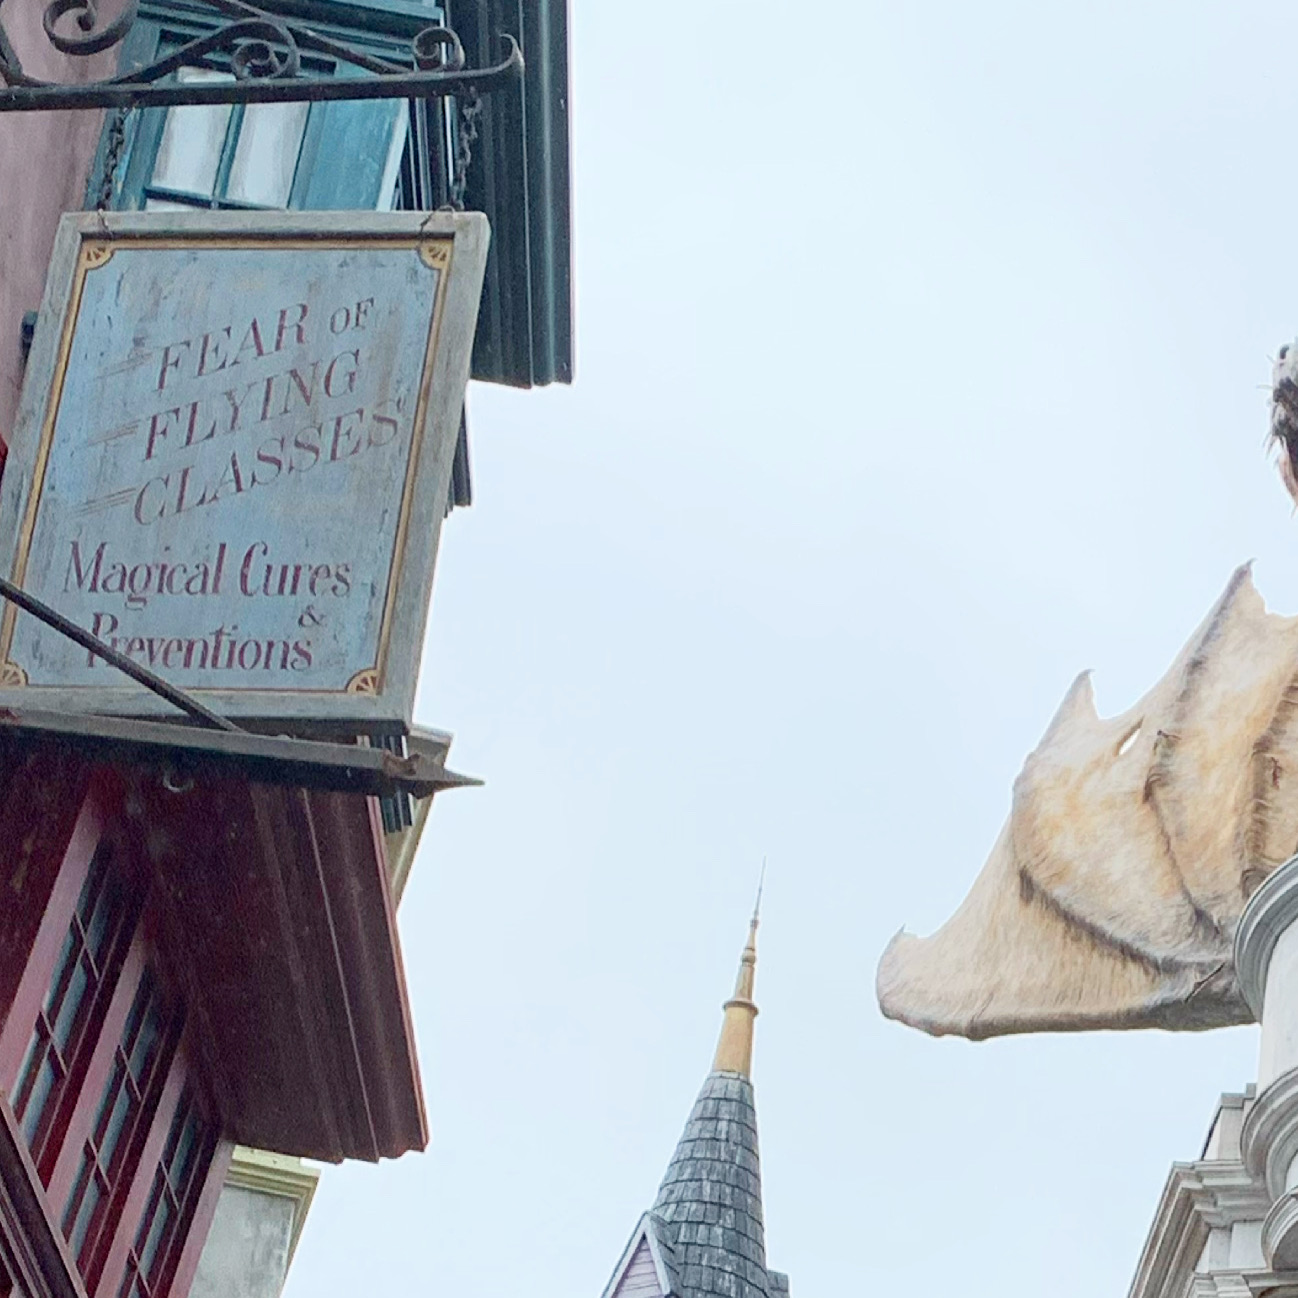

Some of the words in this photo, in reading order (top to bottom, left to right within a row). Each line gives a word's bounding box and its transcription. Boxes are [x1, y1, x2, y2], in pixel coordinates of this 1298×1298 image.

[150, 302, 310, 392] FEAR
[329, 297, 375, 335] OF
[141, 349, 361, 461] FLYING
[133, 396, 401, 525] CLASSES
[63, 541, 229, 611] Magical
[239, 541, 352, 597] Cures
[298, 605, 325, 628] &
